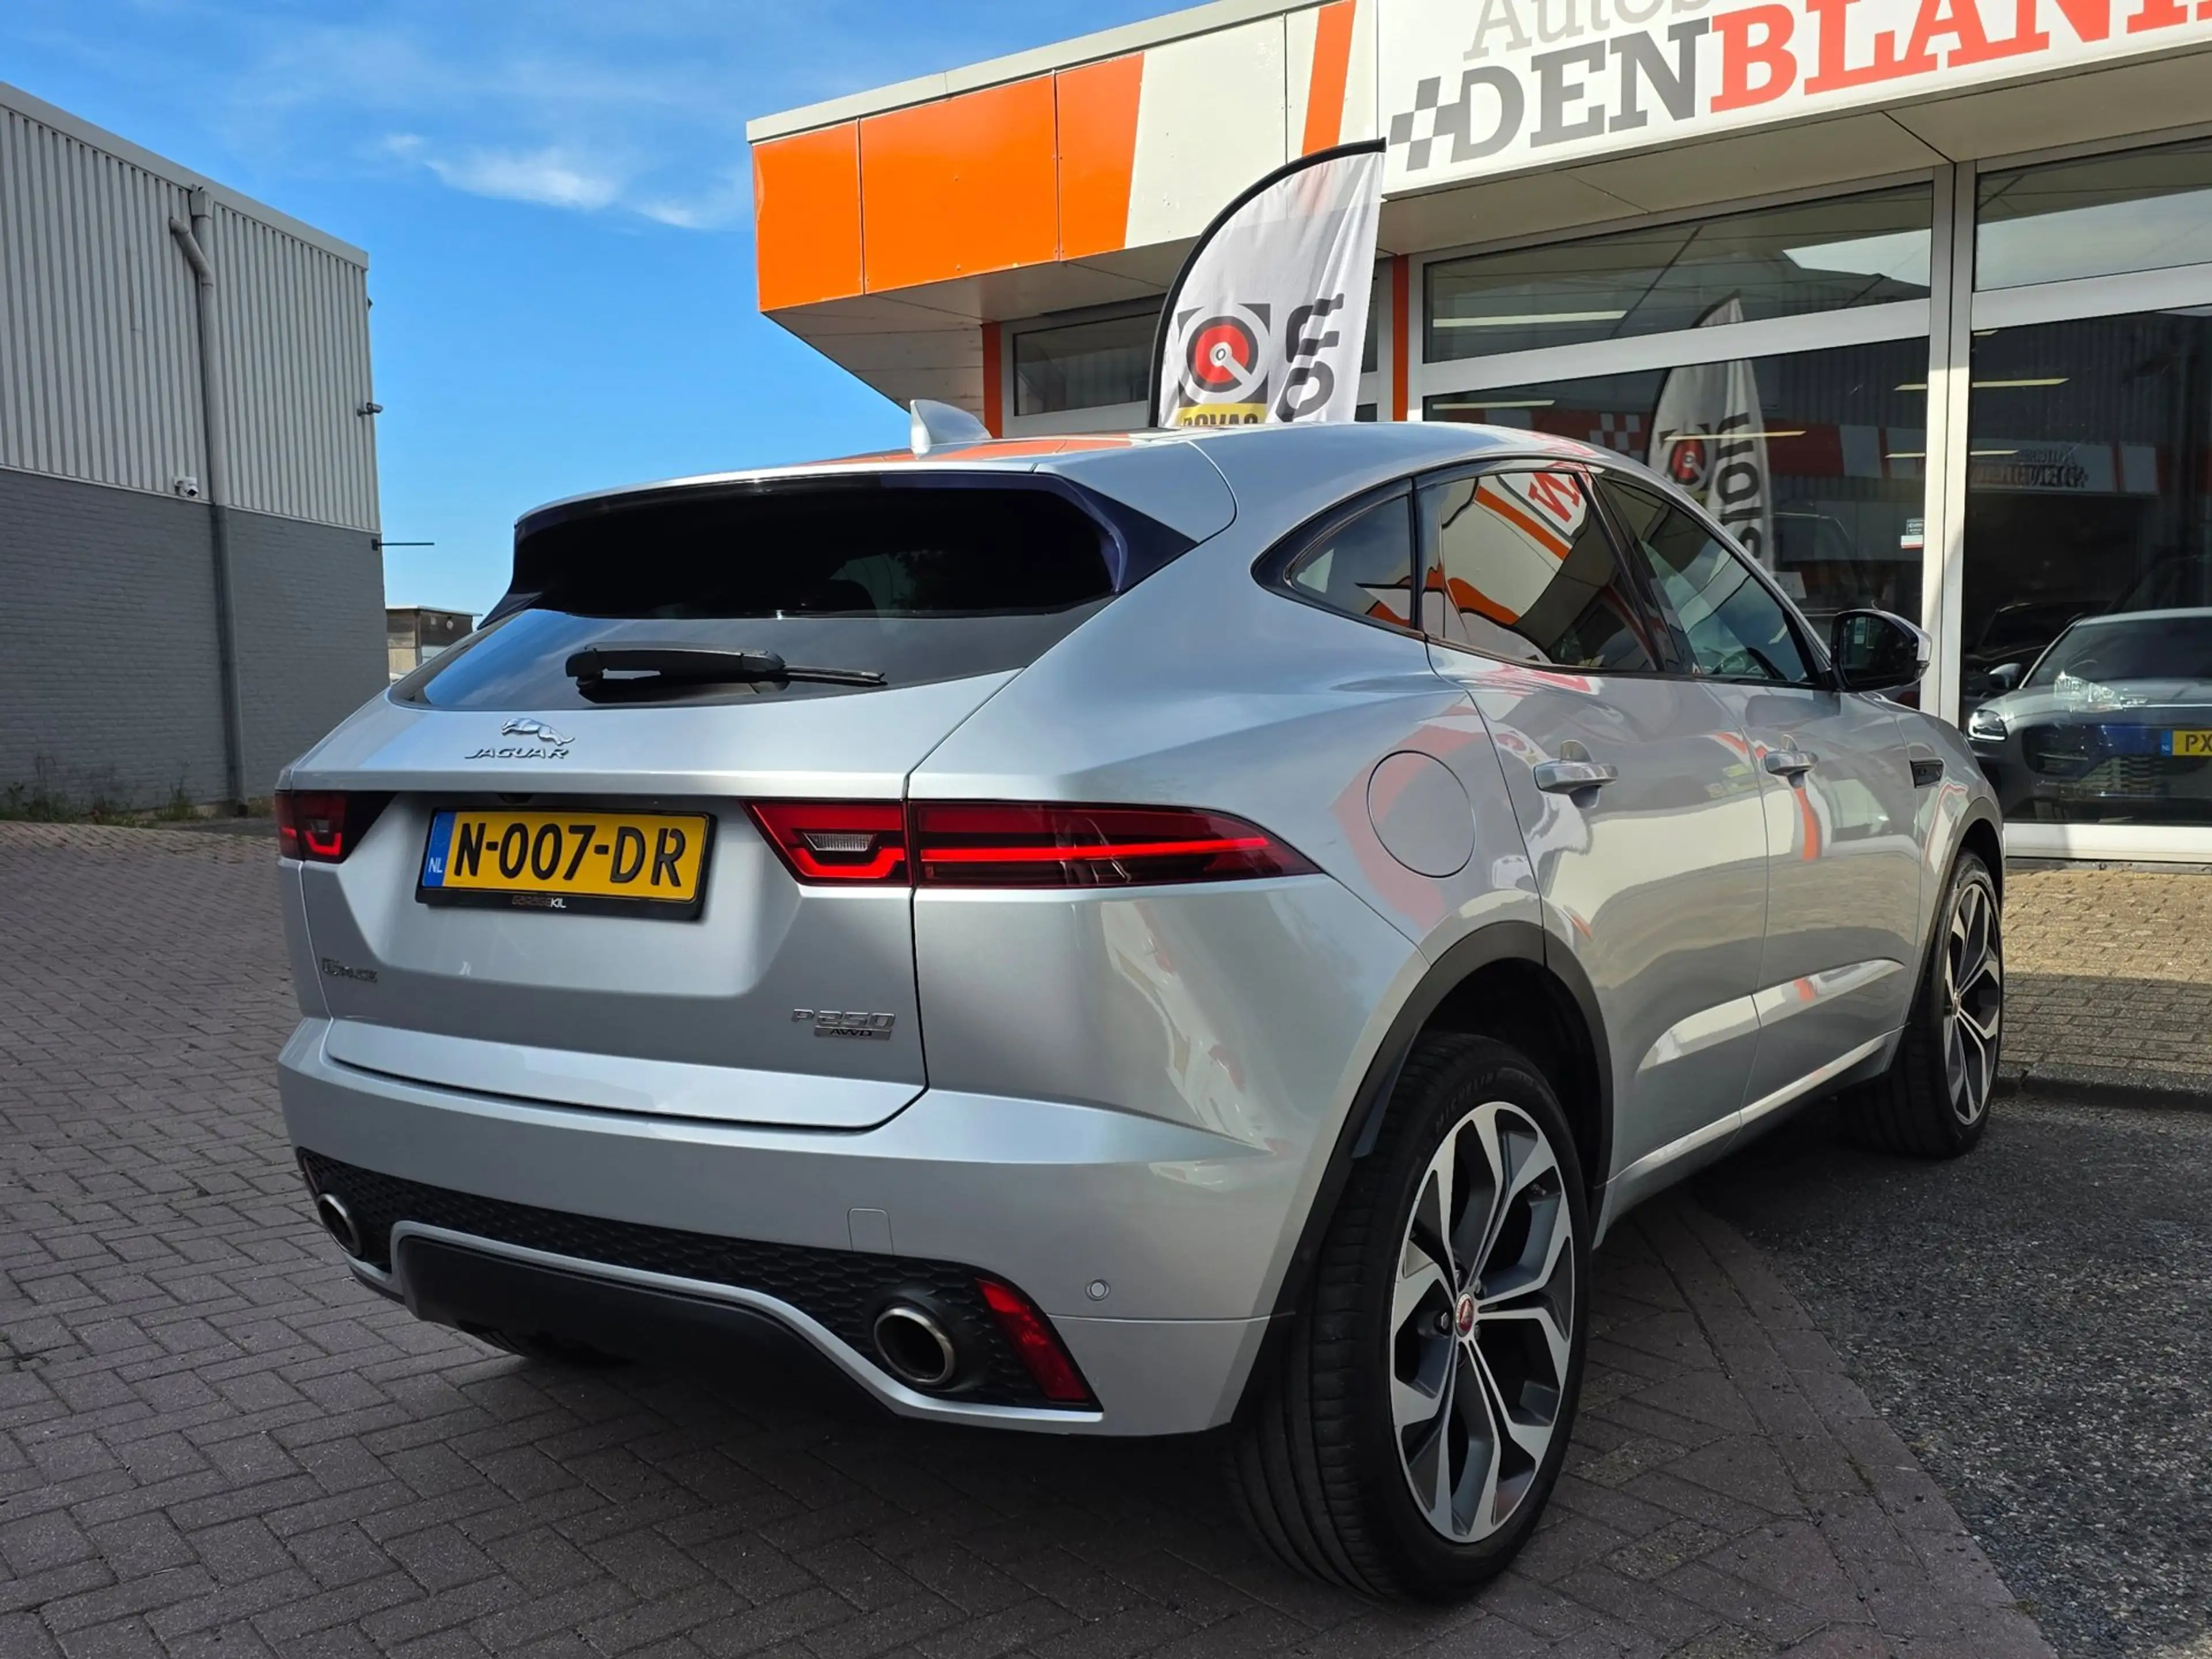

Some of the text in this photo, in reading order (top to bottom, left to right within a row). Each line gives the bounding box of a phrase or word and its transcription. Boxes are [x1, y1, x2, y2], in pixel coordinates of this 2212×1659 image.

[464, 748, 569, 759] JAGUAR
[454, 822, 686, 887] N-007-DR
[428, 857, 443, 873] NL
[791, 1009, 896, 1028] P250
[830, 1029, 875, 1037] AWD
